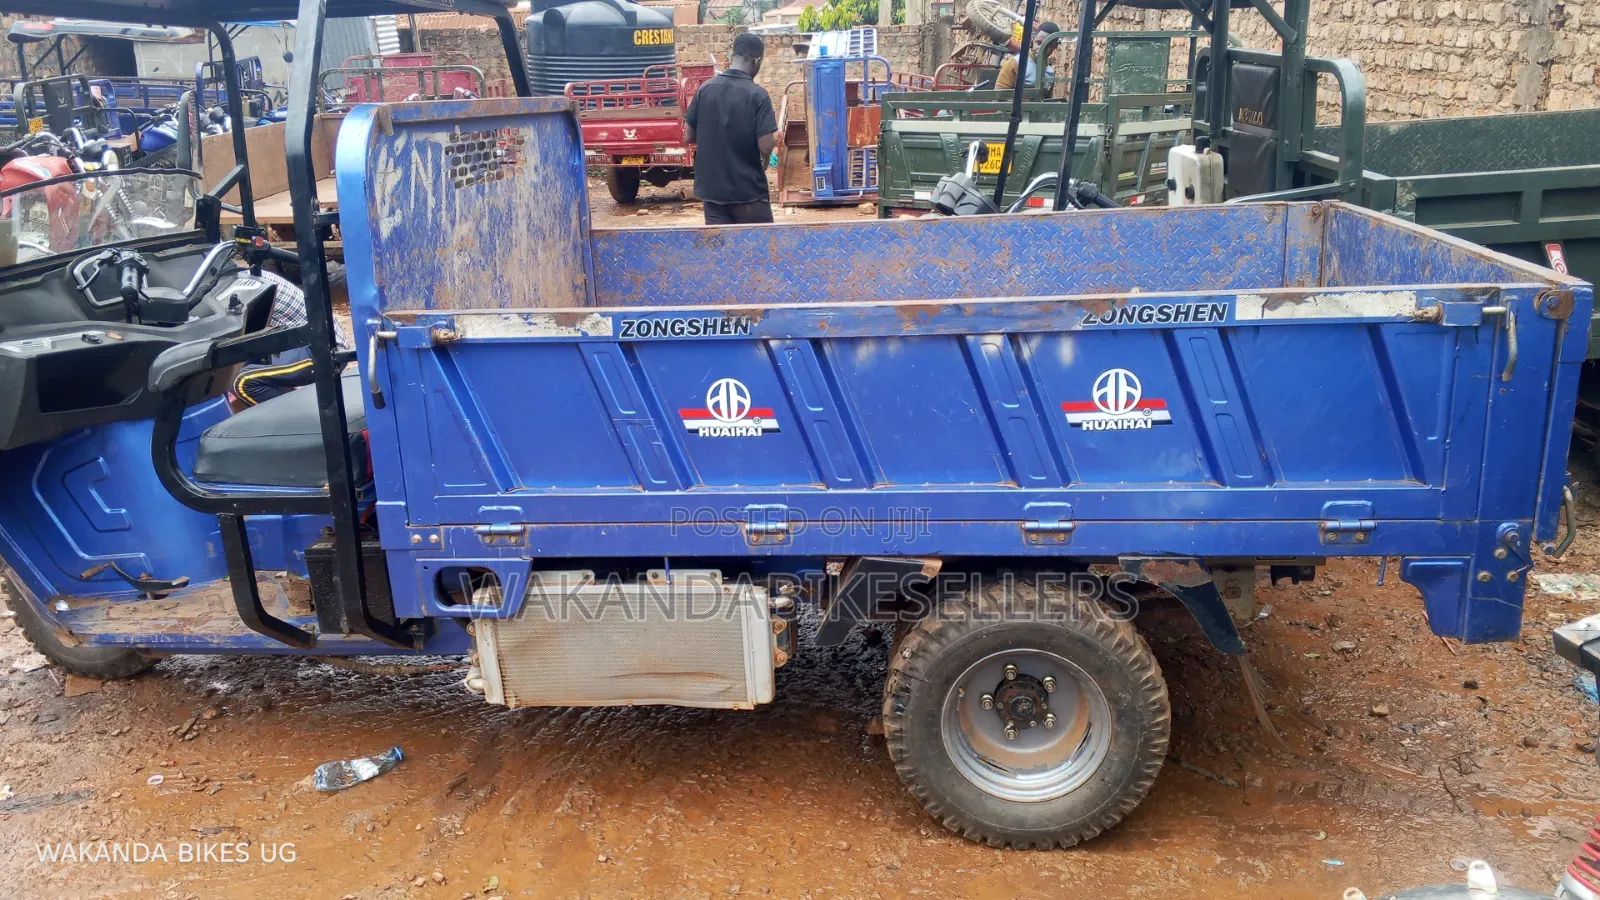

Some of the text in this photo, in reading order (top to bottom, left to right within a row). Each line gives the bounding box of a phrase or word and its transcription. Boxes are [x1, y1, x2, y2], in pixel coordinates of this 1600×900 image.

[620, 316, 750, 338] ZONGSHEN
[1081, 418, 1152, 431] HUAIHAI
[699, 426, 762, 438] HUAIHAI
